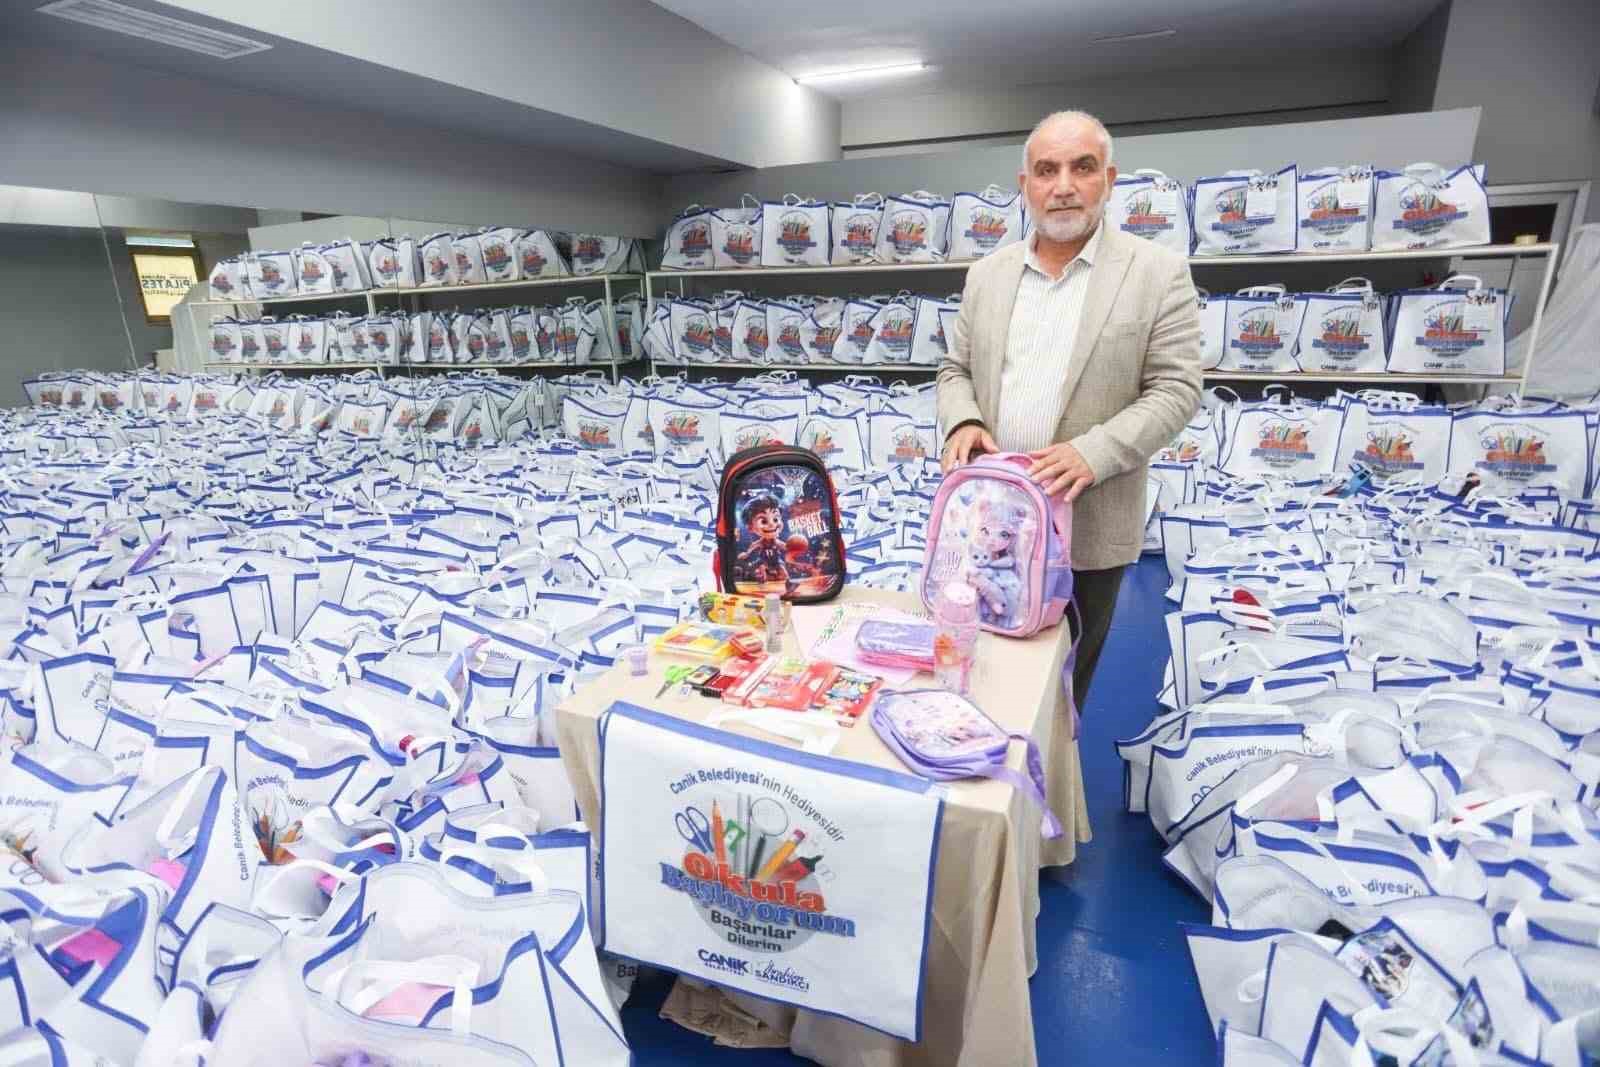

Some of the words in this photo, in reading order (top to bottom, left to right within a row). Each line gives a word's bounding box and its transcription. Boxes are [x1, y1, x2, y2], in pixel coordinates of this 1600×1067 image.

[787, 511, 822, 532] BASKET
[807, 520, 829, 538] BALL
[670, 774, 697, 794] Canik
[699, 767, 781, 793] Belediyesi'nin
[783, 785, 846, 842] Hediyesidir
[683, 852, 827, 913] Okula
[659, 862, 856, 938] Başlıyorum
[710, 909, 797, 940] Başarılar
[727, 932, 782, 953] Dilerim
